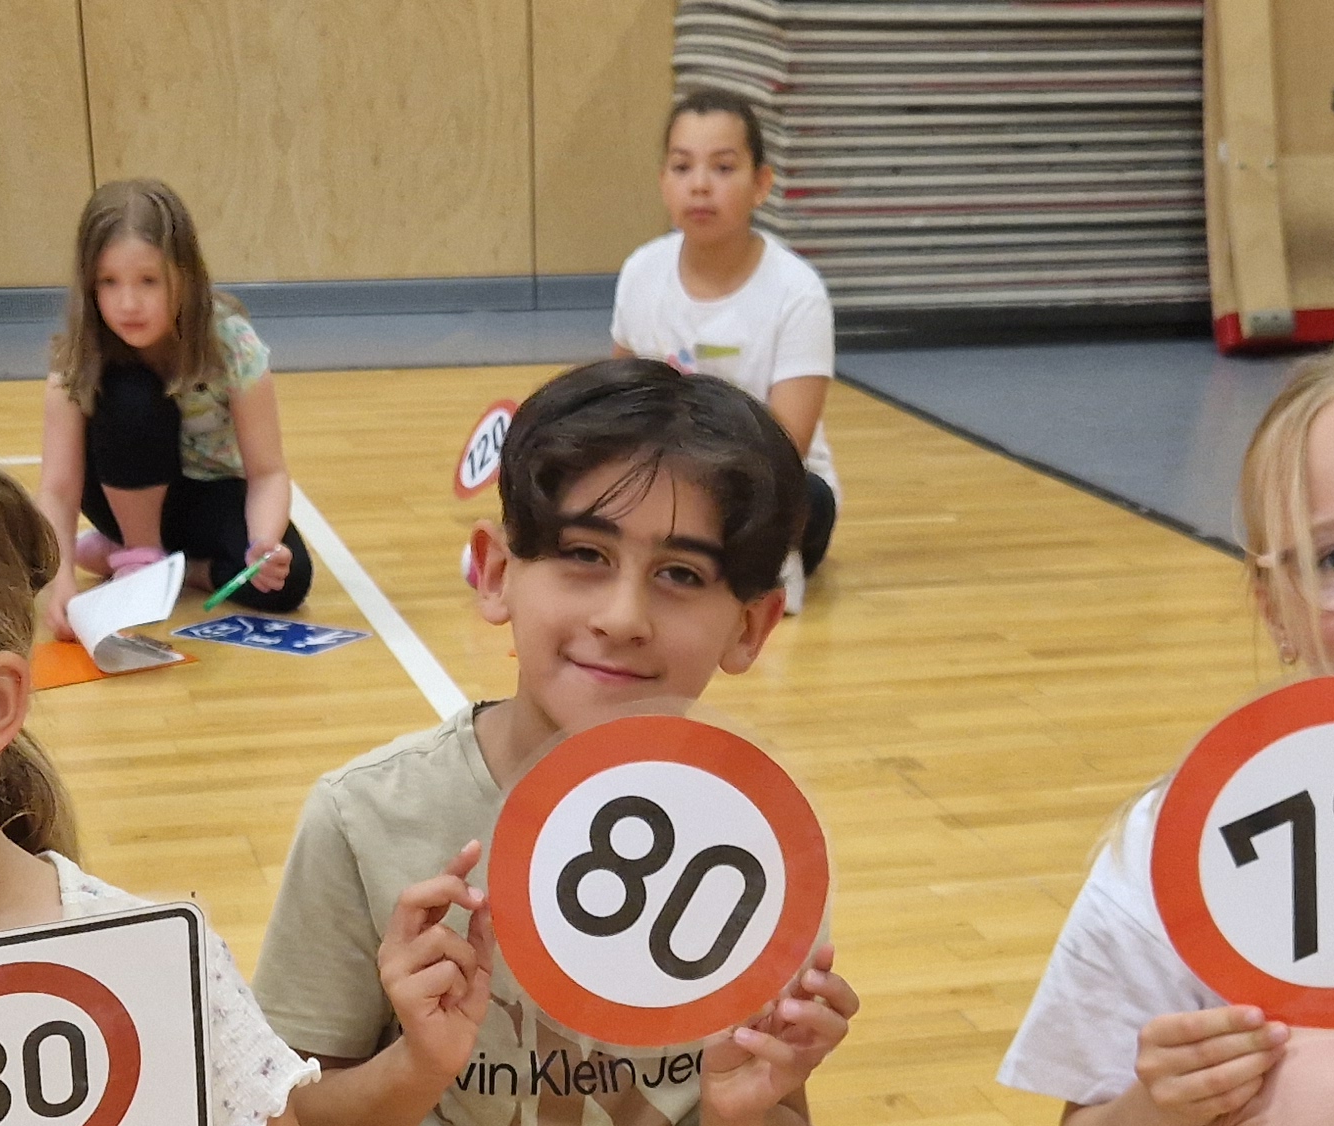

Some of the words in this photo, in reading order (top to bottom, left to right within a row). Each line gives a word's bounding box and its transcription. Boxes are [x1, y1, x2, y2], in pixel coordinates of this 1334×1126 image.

[467, 416, 507, 480] 120
[556, 795, 767, 980] 80
[455, 1052, 518, 1096] vin
[529, 1049, 636, 1096] Klein
